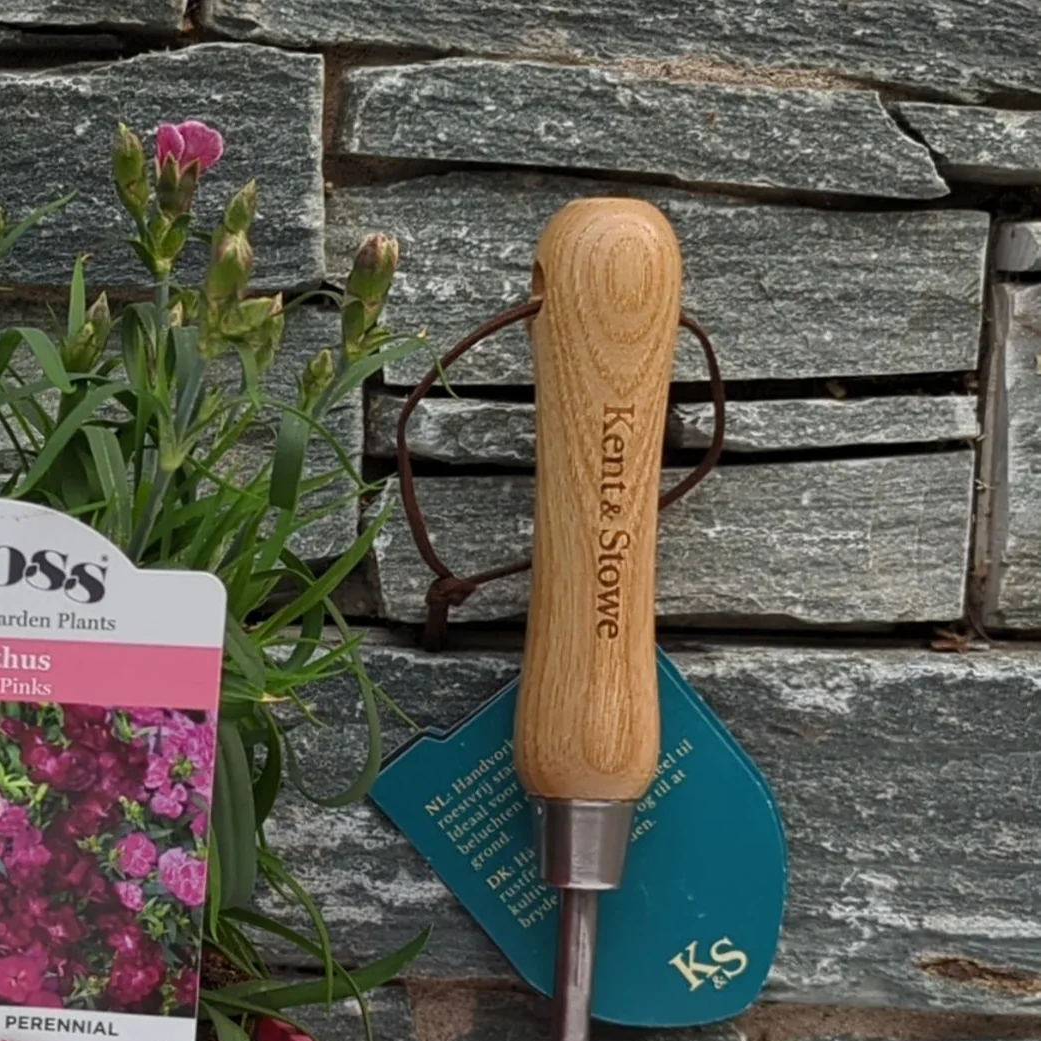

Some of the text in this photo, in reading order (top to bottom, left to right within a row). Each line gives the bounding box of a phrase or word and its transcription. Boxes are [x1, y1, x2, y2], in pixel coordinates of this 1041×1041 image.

[596, 403, 635, 640] Kent & Stowe
[57, 612, 116, 632] Plants
[0, 677, 52, 696] Pinks
[654, 752, 677, 778] eel
[676, 738, 693, 757] til
[425, 793, 453, 816] NL:
[636, 794, 656, 812] og
[654, 779, 671, 797] til
[670, 769, 687, 784] at
[447, 782, 518, 841] Ideaal voor
[457, 801, 524, 855] beluchten
[471, 831, 514, 871] grond.
[486, 865, 515, 890] DK:
[6, 1015, 119, 1037] PERENNIAL
